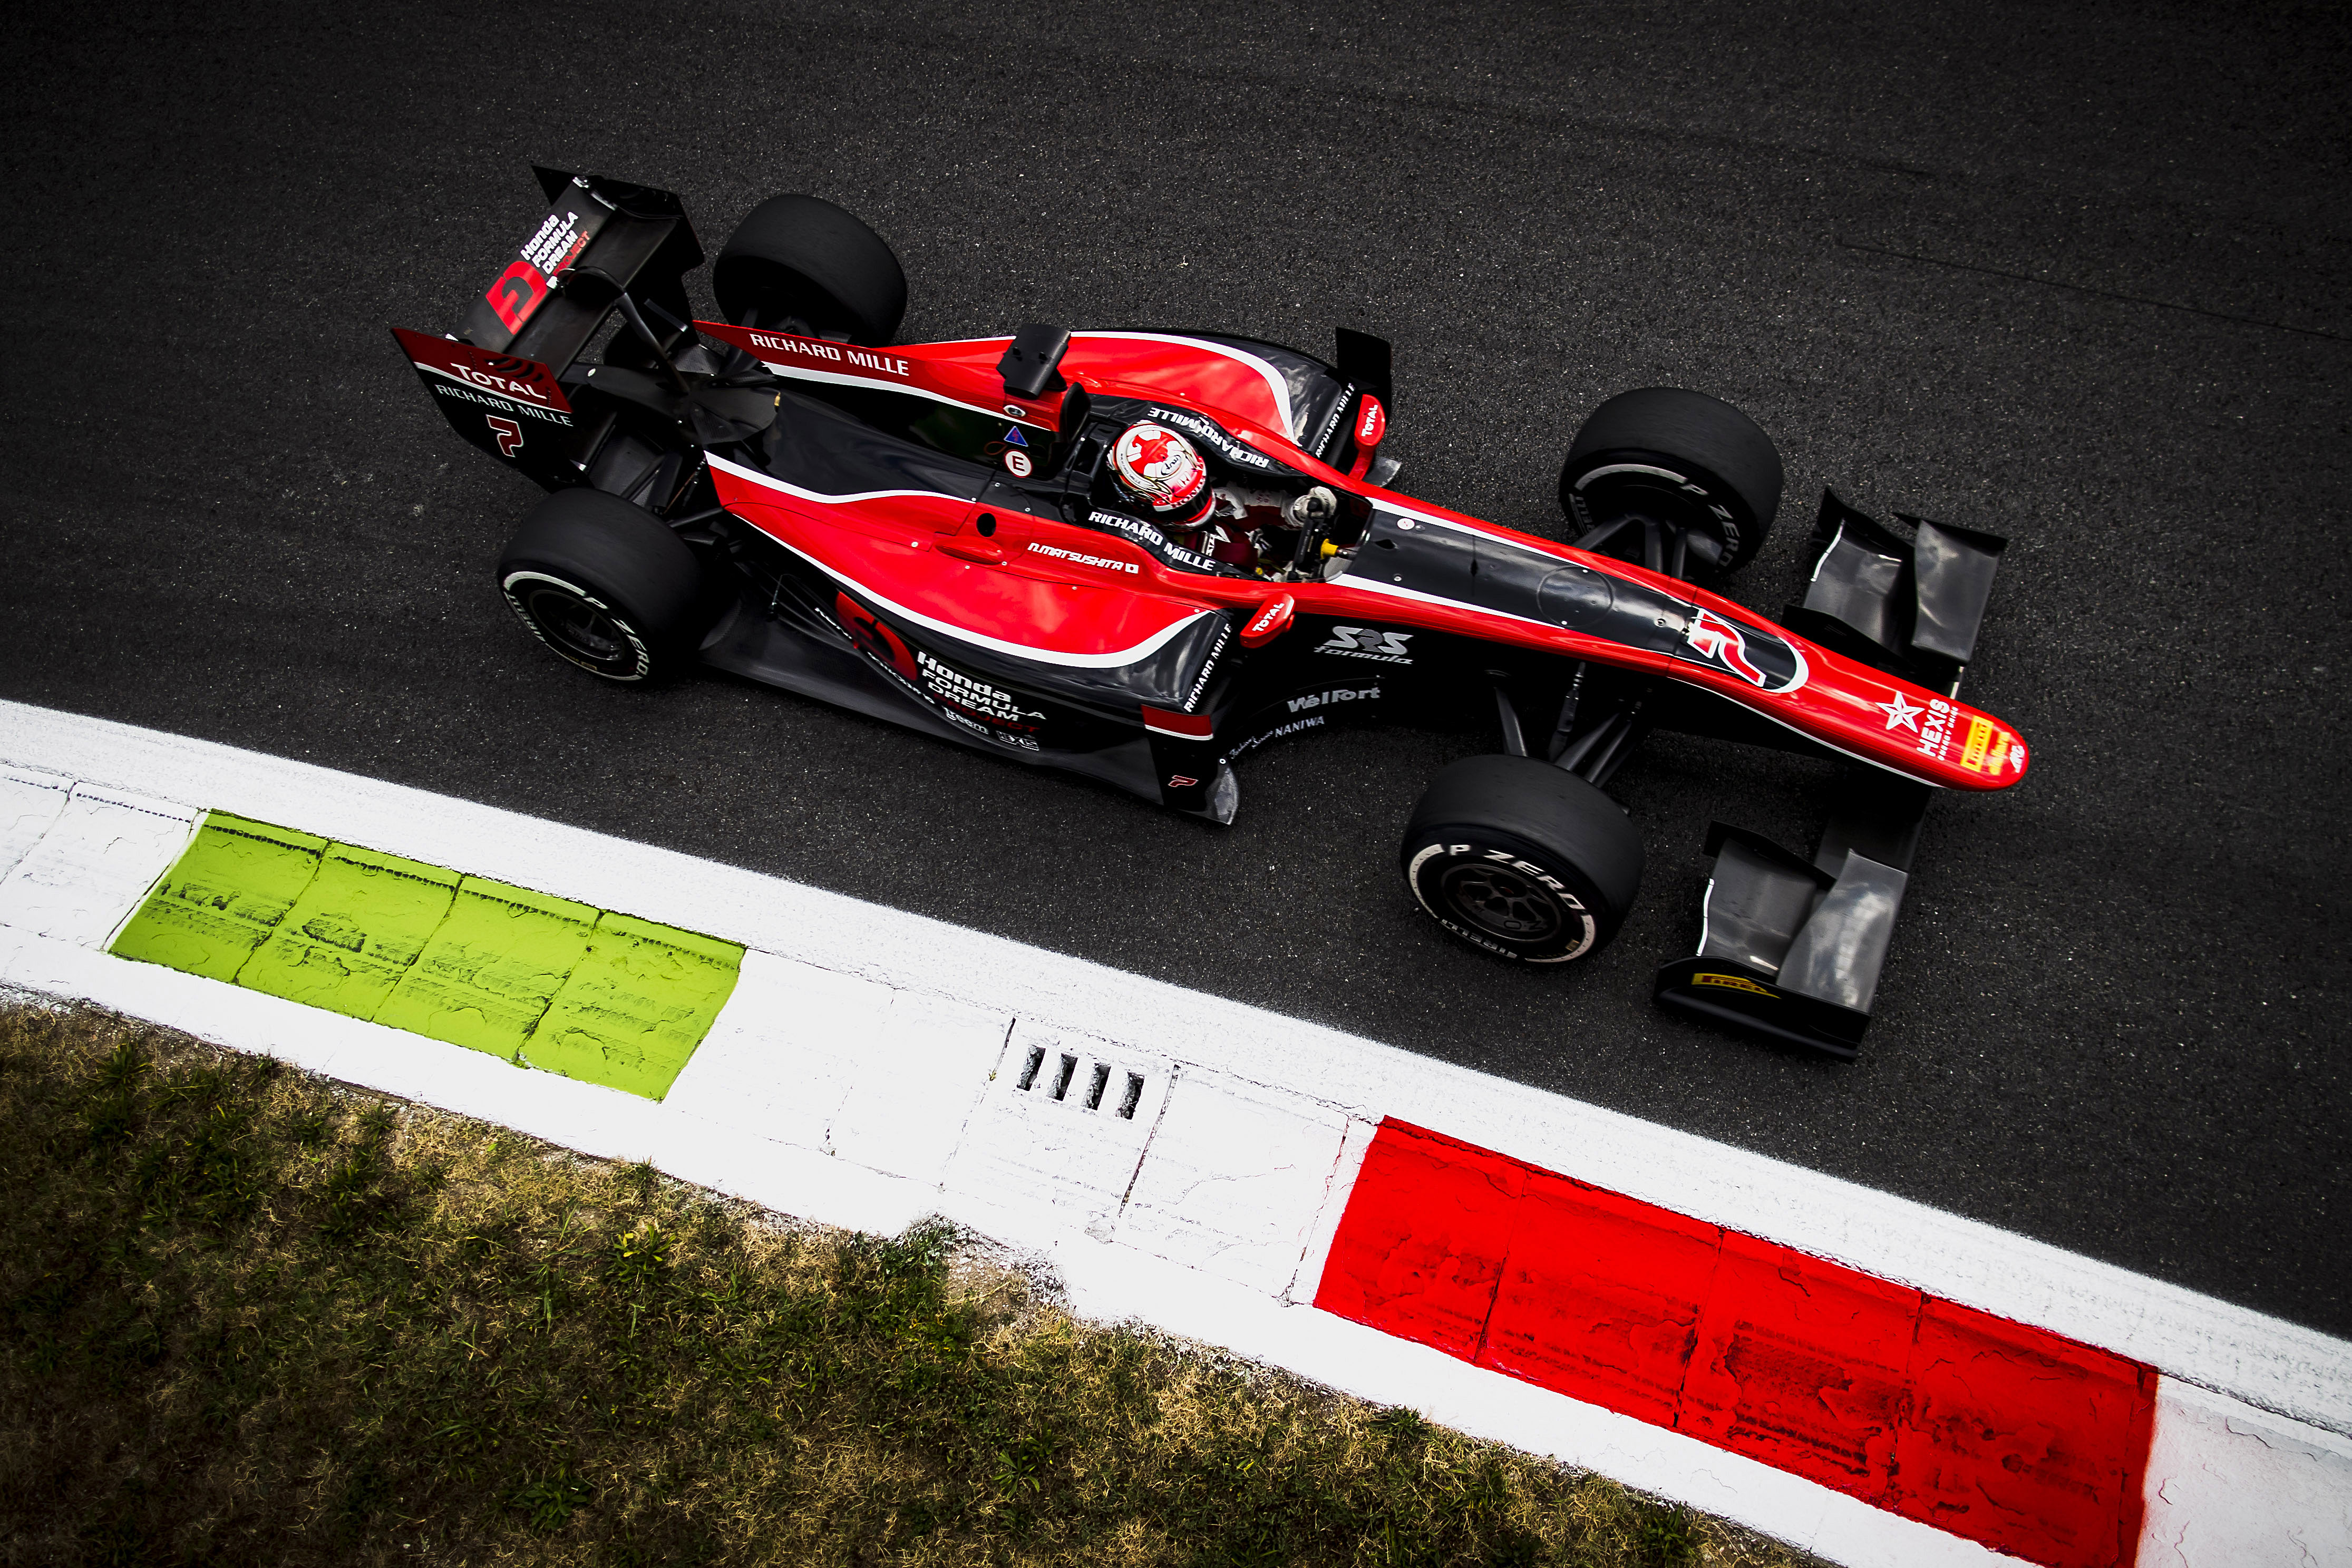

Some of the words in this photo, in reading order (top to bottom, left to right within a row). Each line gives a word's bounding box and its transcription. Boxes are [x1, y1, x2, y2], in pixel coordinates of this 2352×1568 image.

[520, 215, 560, 260] Honda
[531, 211, 579, 268] FORMULA
[542, 230, 578, 275] DREAM
[749, 333, 841, 361] RICHARD
[846, 350, 909, 376] MILLE
[450, 362, 547, 400] TOTAL
[435, 384, 514, 412] RICHARD
[517, 405, 574, 426] MILLE
[1147, 407, 1201, 430] MILLE
[1361, 404, 1378, 437] TOTAL
[485, 414, 524, 457] 7
[1200, 424, 1270, 468] RICHARD
[1012, 455, 1025, 472] E
[1088, 511, 1163, 546] RICHARD
[1164, 542, 1216, 571] MILLE
[1680, 483, 1709, 495] P
[1708, 504, 1741, 567] ZERO
[1252, 603, 1285, 631] TOTAL
[1687, 608, 1766, 687] 7
[917, 651, 1012, 703] Honda
[922, 669, 1047, 720] FORMULA
[1183, 660, 1214, 713] RICHARD
[928, 681, 1019, 722] DREAM
[933, 693, 1041, 733] PROJECT
[1275, 716, 1324, 737] NANIWA
[1916, 698, 1950, 757] HEXIS
[1450, 845, 1471, 855] P
[1484, 849, 1586, 910] ZERO
